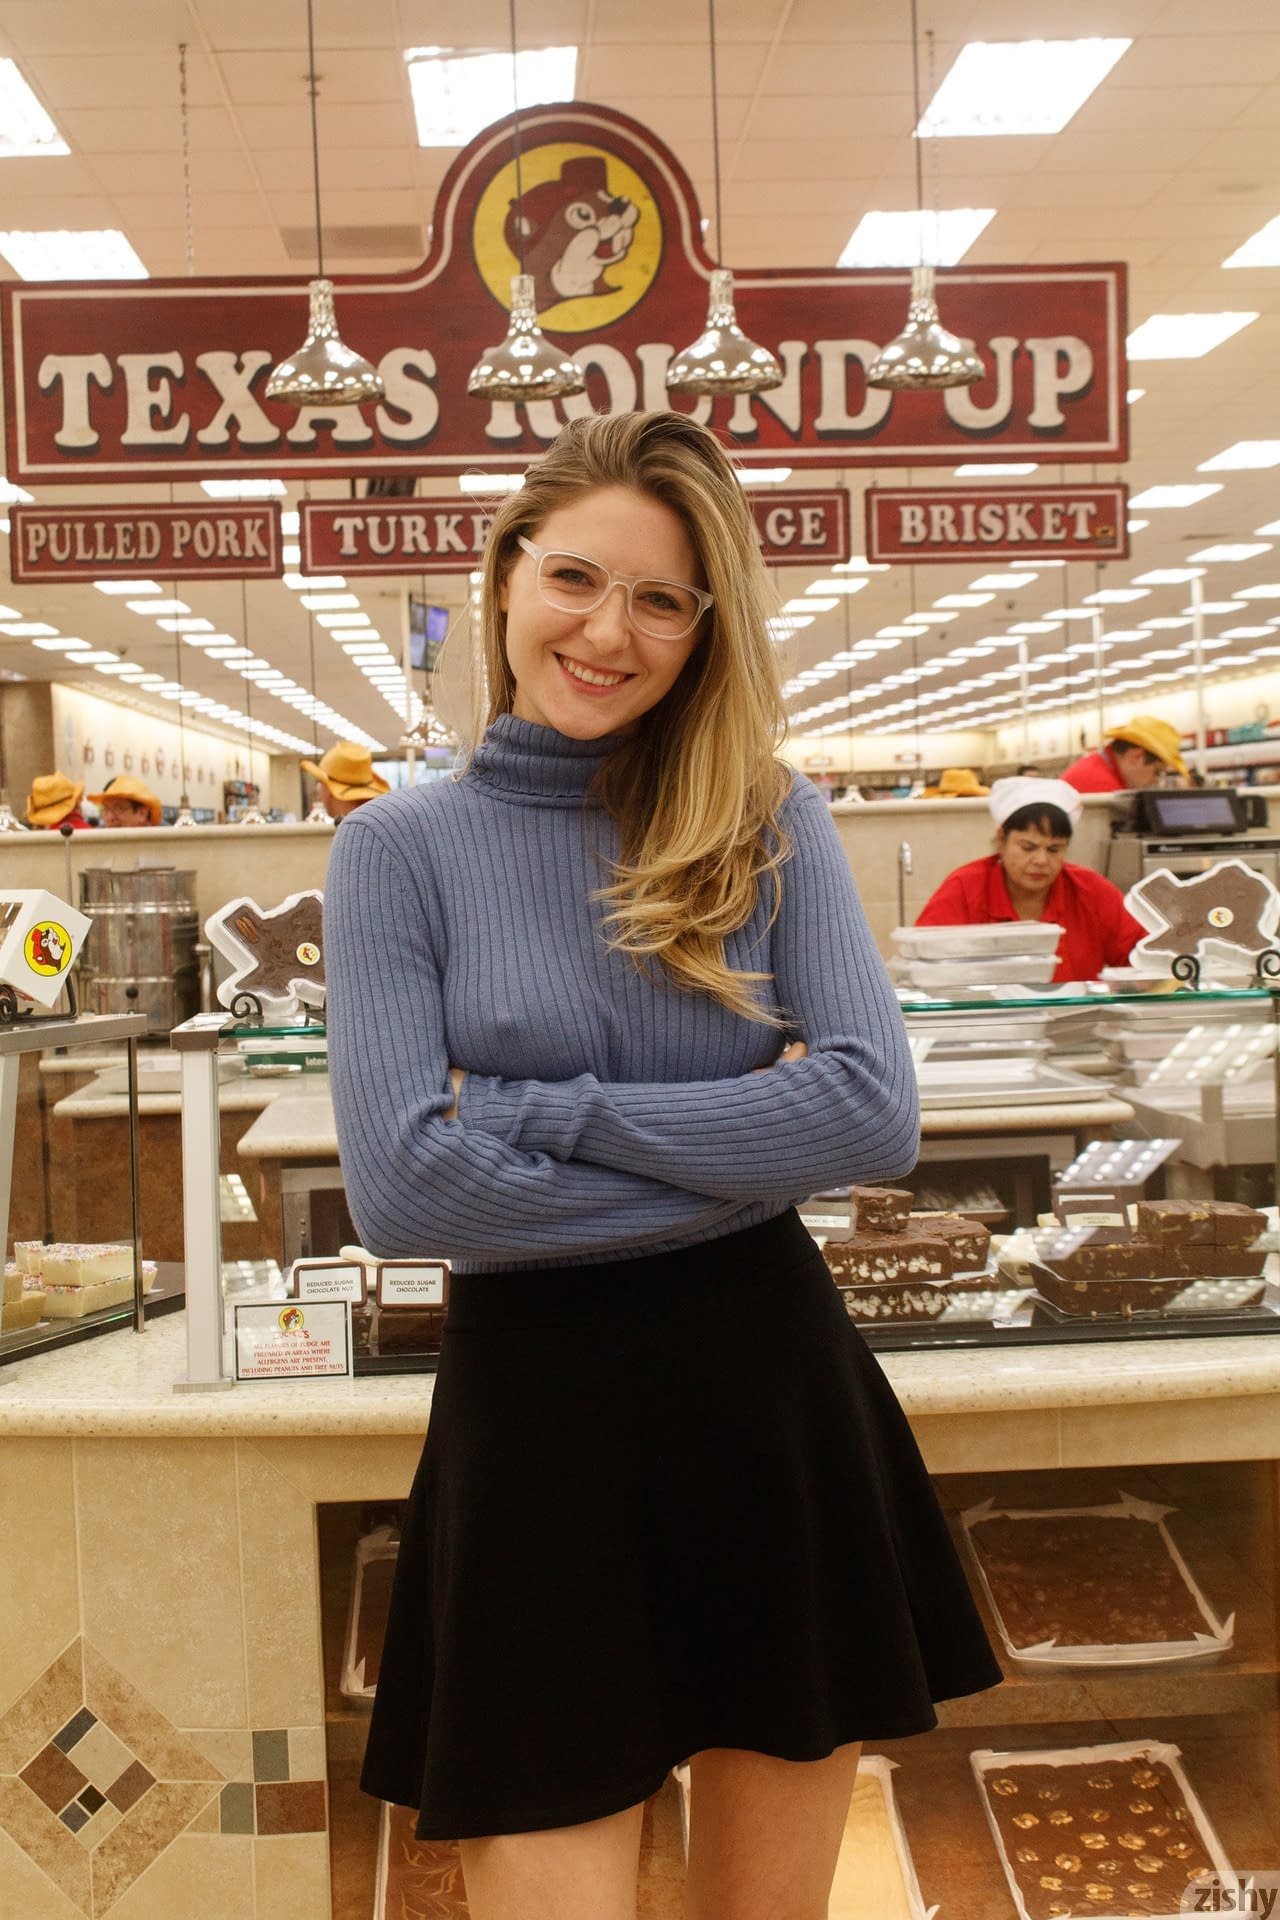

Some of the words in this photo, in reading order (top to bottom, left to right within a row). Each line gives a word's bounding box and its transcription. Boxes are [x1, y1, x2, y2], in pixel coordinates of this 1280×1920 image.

[944, 336, 1094, 430] UP
[26, 520, 161, 562] PULLED
[171, 518, 268, 559] PORK
[899, 501, 1097, 544] BRISKET
